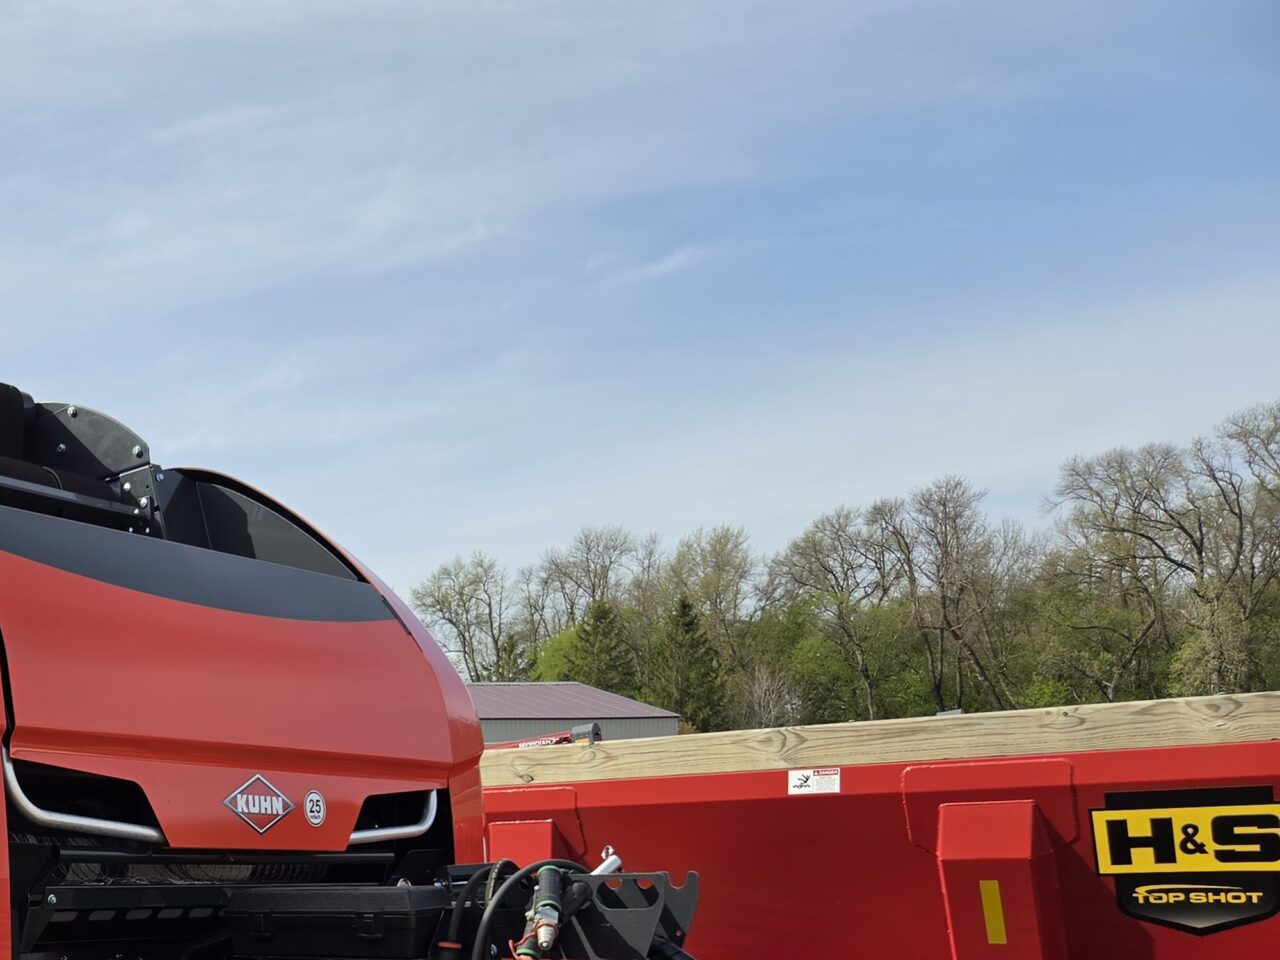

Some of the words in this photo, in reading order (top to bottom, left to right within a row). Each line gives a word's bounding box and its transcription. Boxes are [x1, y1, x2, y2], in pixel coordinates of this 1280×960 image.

[236, 793, 284, 815] KUHN
[308, 798, 322, 815] 25
[1105, 813, 1280, 866] H&S
[1132, 891, 1186, 904] TOP
[1189, 891, 1263, 904] SHOT
